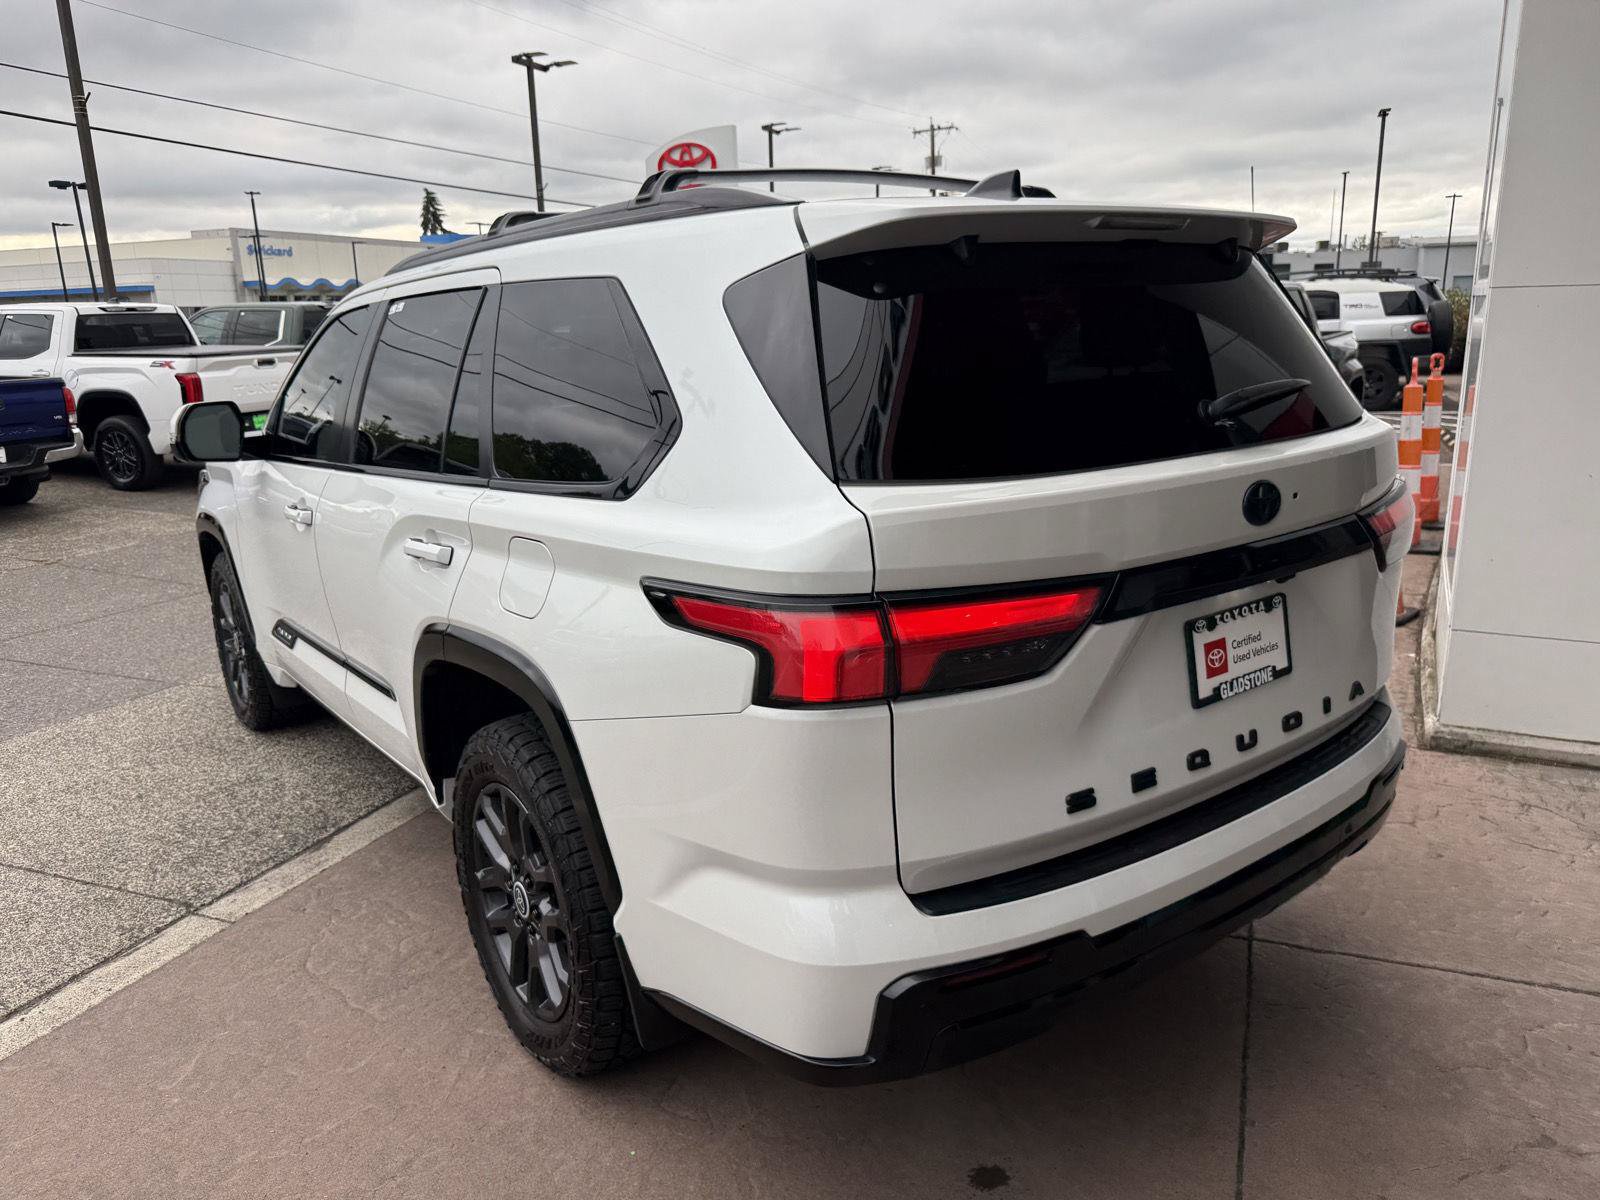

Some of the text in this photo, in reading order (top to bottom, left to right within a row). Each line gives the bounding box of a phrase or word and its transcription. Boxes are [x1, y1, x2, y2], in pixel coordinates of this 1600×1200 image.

[1215, 601, 1265, 625] TOYOTA
[1231, 631, 1262, 650] Certified
[1233, 642, 1279, 664] Used Vehicles
[1220, 666, 1274, 700] GLADSTONE
[1065, 680, 1365, 814] SEQUOIA
